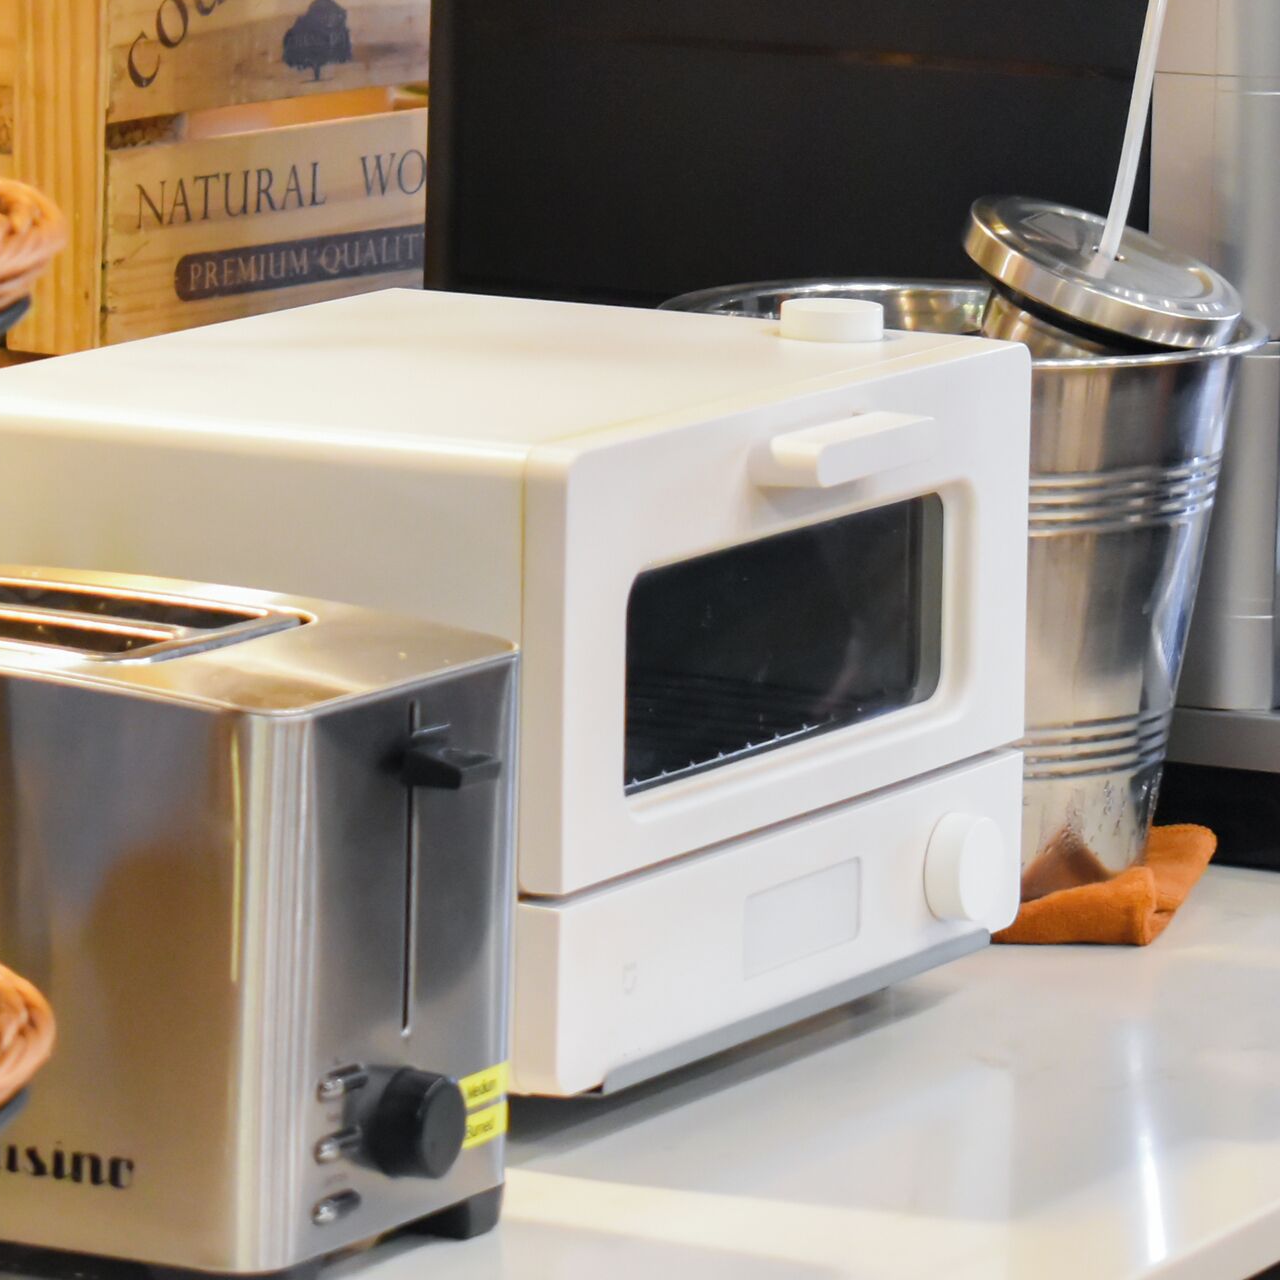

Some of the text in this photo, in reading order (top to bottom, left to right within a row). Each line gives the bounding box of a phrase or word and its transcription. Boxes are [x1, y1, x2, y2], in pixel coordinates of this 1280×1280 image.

[135, 149, 427, 230] NATURAL WO
[189, 231, 426, 292] PREMIUM QUALIT
